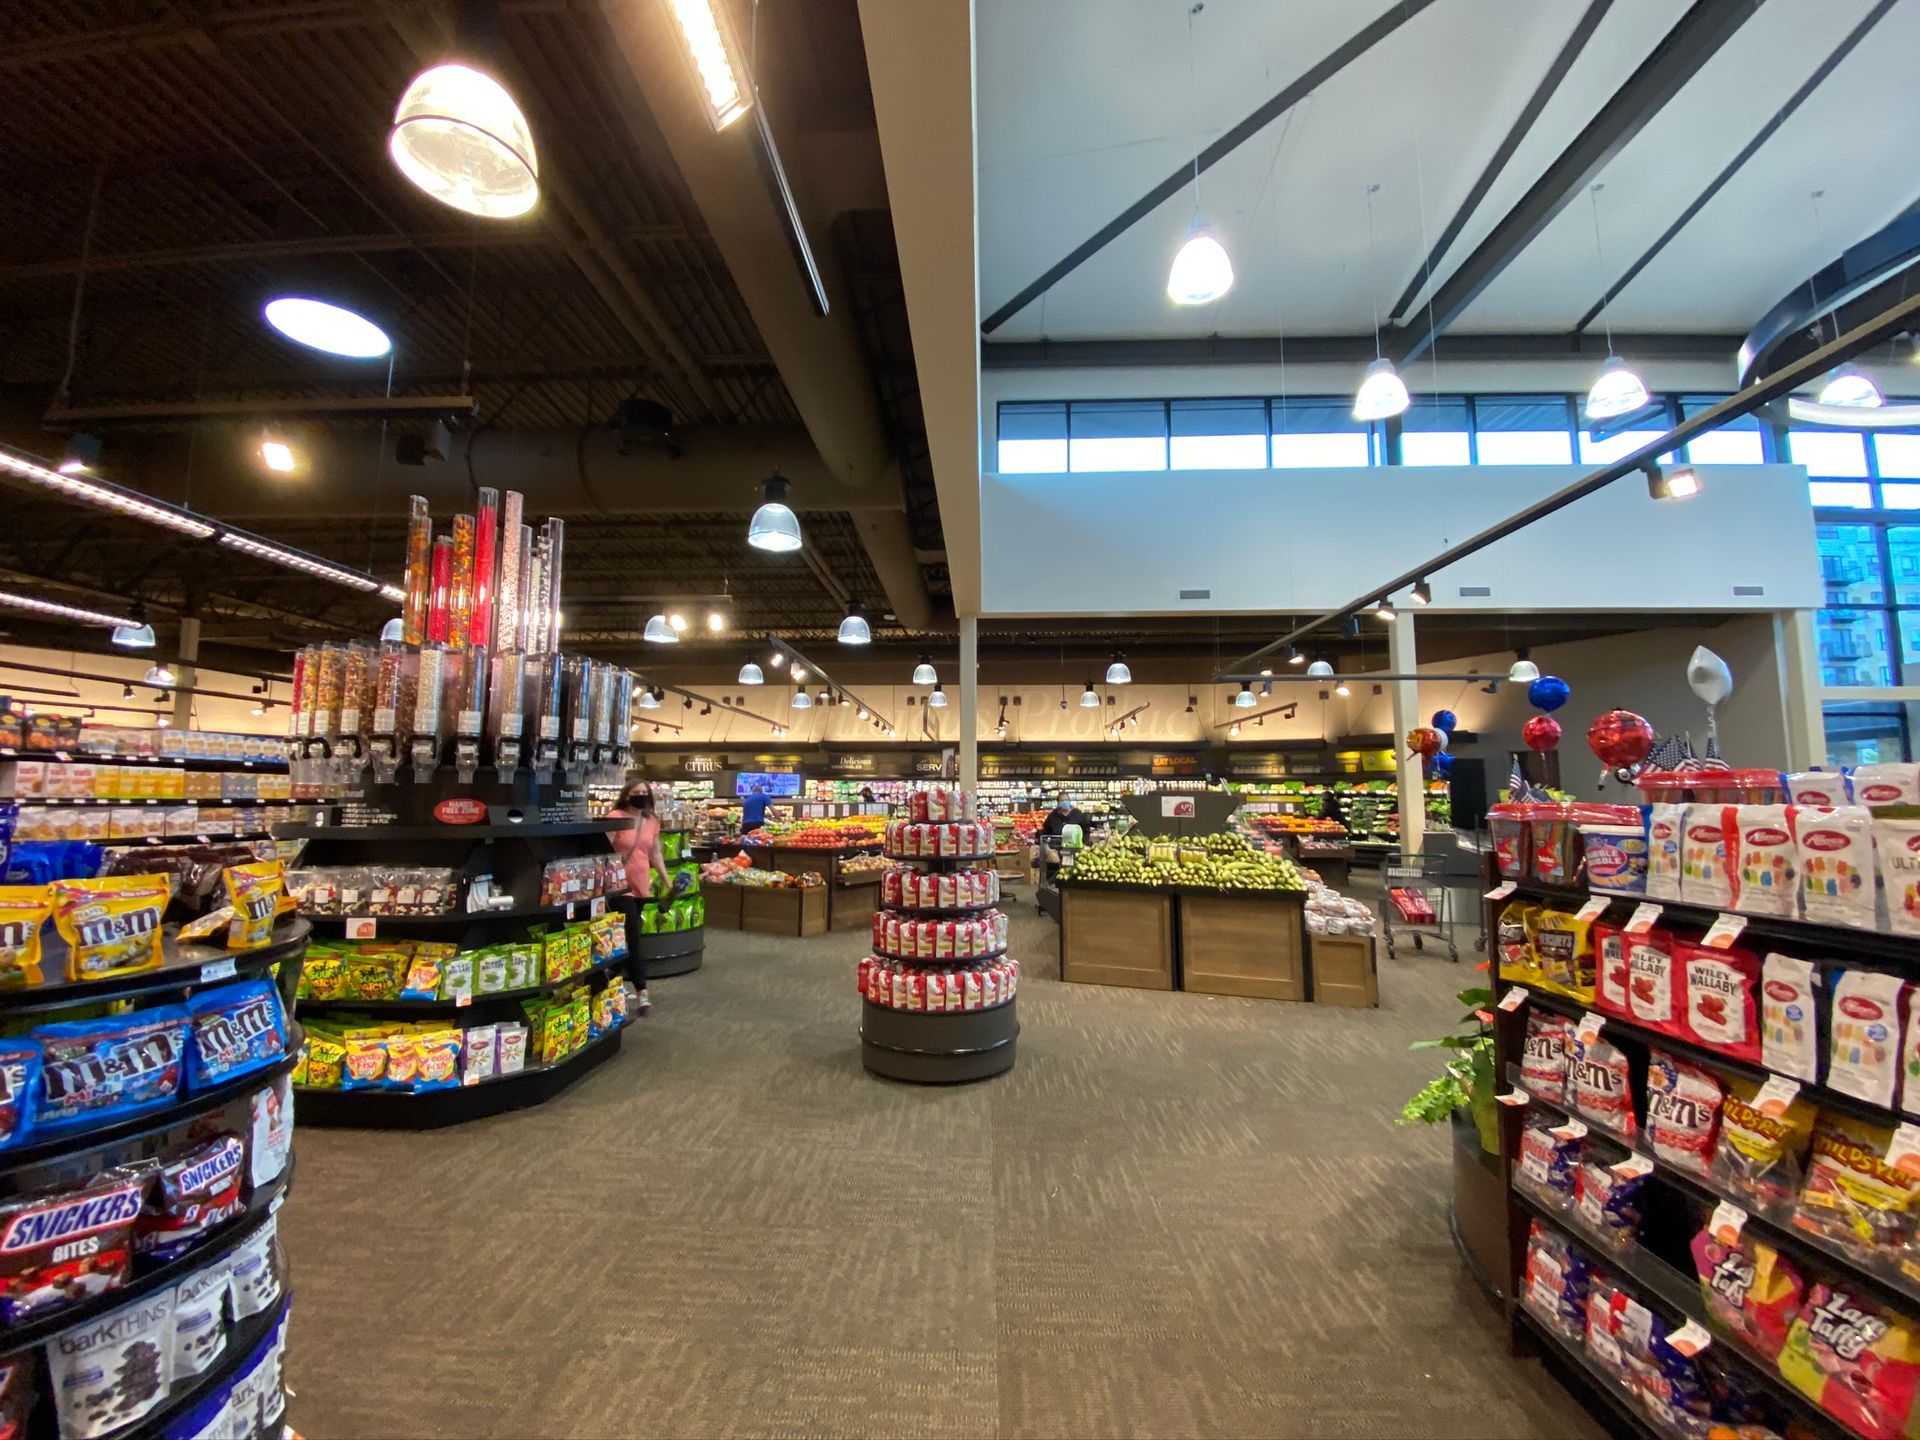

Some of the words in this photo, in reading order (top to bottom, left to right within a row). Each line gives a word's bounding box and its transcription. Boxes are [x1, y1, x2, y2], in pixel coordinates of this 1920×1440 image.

[685, 760, 723, 772] CITRUS
[840, 756, 872, 765] Delicious
[1690, 973, 1738, 996] WALLABY
[1694, 966, 1730, 981] WILEY
[181, 1148, 242, 1194] SNICKERS
[6, 1190, 140, 1249] SNICKERS
[53, 1236, 100, 1263] BITES
[60, 1304, 168, 1354] barkTHINS
[1809, 1306, 1869, 1360] Taffy
